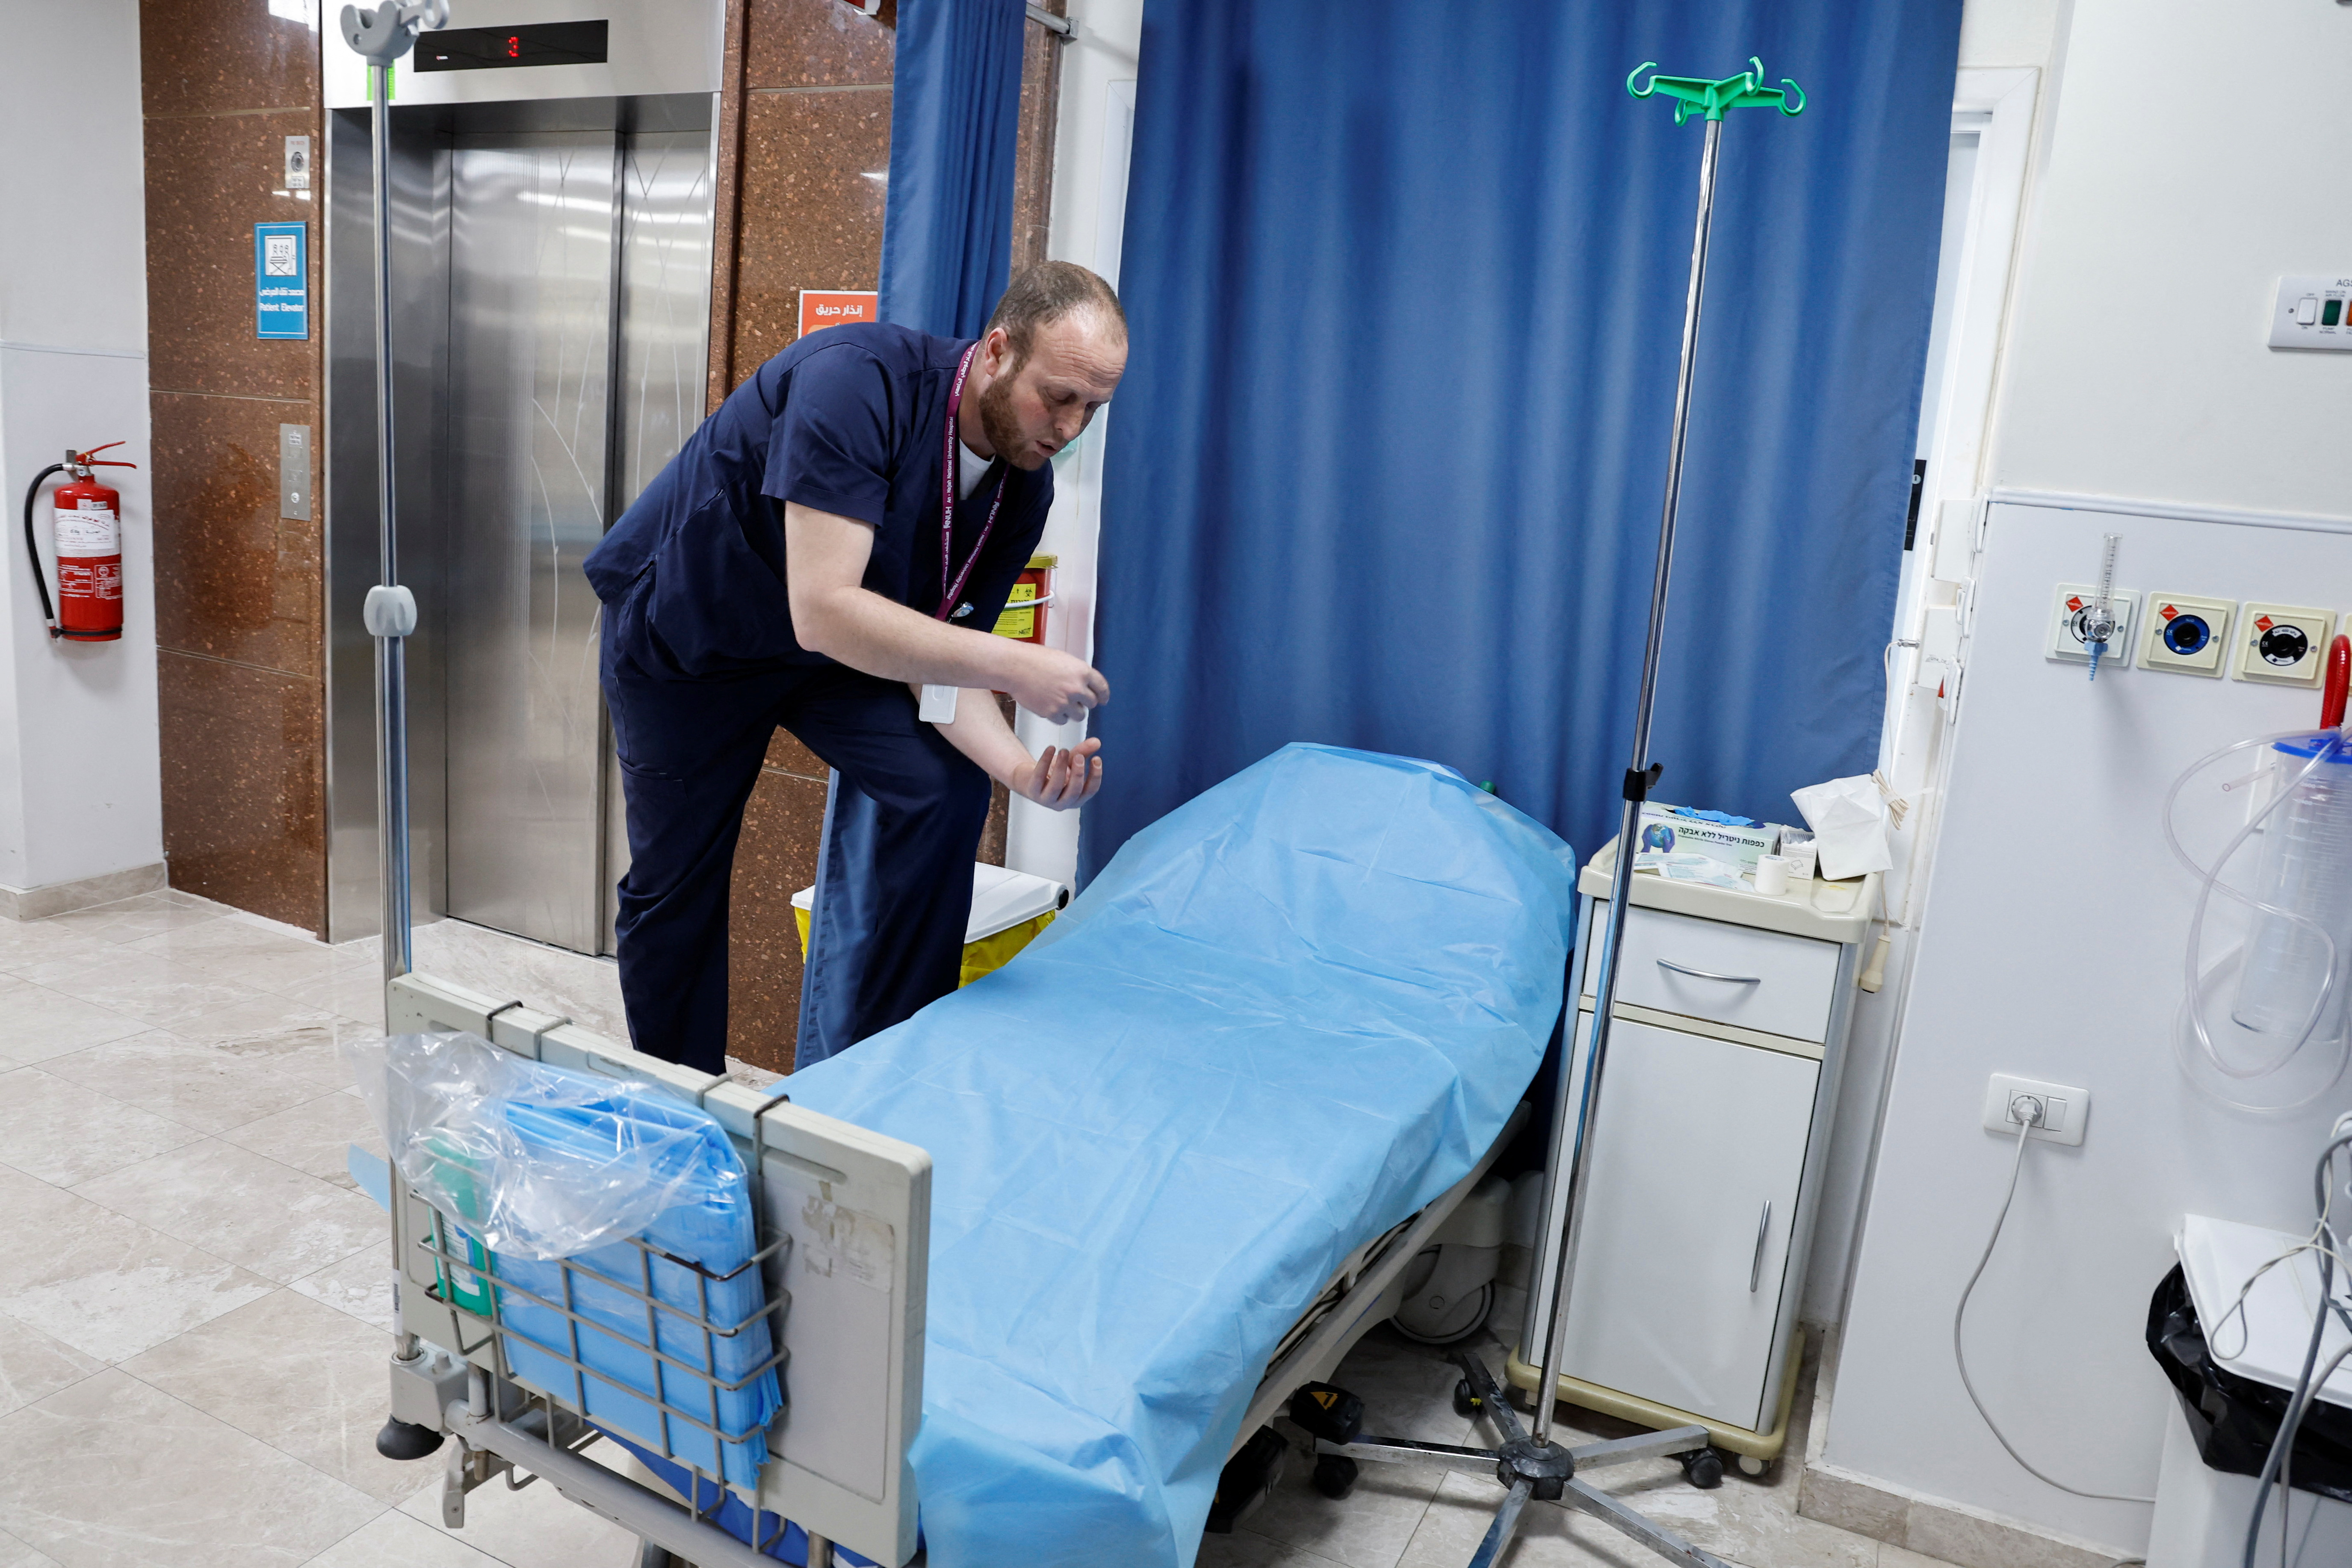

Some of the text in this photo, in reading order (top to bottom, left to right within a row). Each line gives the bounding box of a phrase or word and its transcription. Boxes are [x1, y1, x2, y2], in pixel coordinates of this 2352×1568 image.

[508, 37, 519, 57] 3
[281, 303, 304, 311] Elevator
[815, 304, 863, 317] إنذار حريق
[967, 546, 979, 564] National
[956, 563, 970, 583] University
[946, 583, 959, 600] Hospital
[1678, 827, 1764, 847] כפפות ניטריל ללא אבקה
